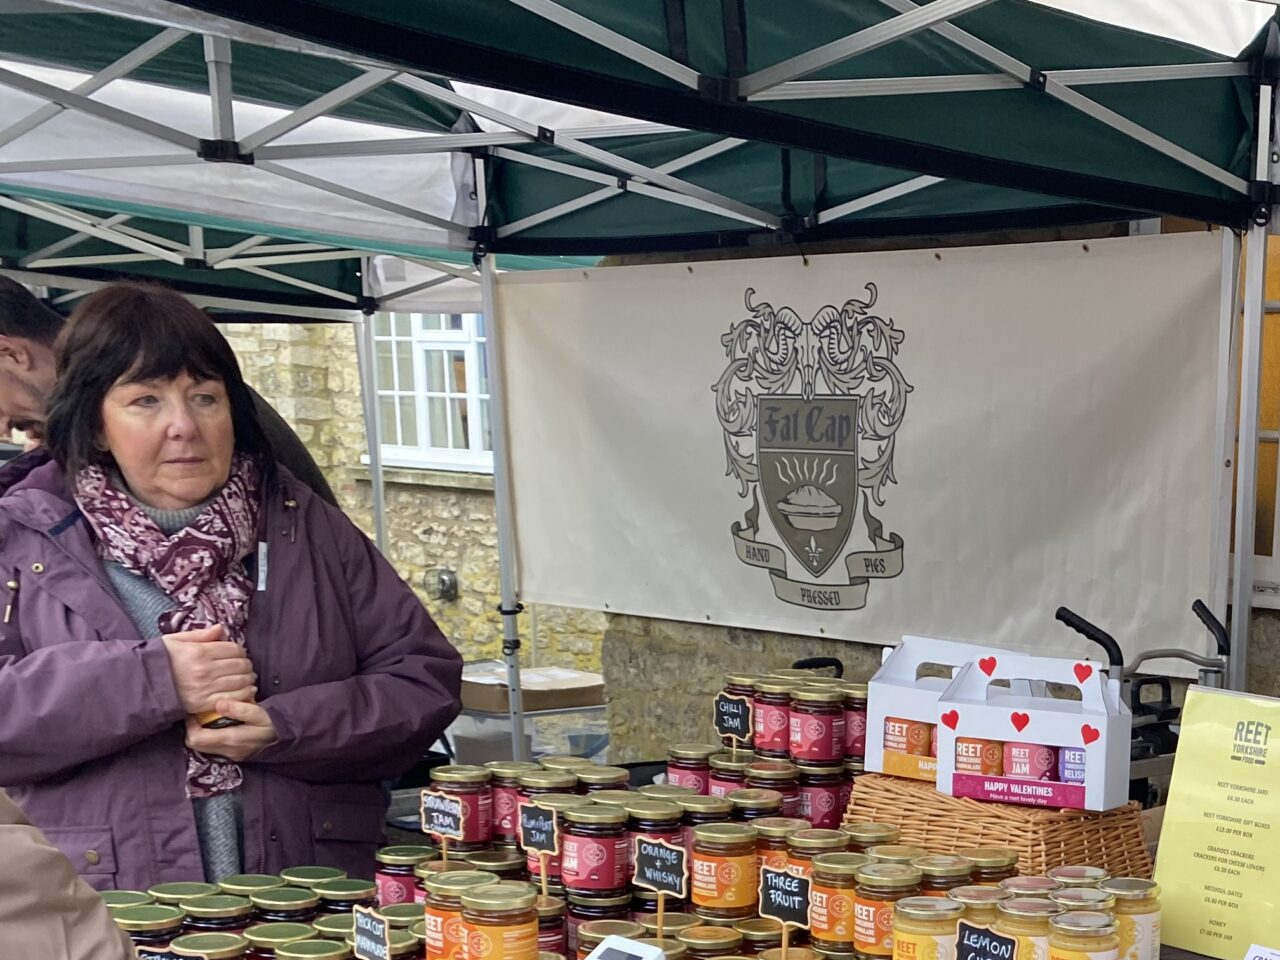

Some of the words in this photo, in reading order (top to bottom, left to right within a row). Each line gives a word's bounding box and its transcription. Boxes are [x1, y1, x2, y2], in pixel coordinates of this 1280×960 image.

[804, 405, 851, 447] Cap
[745, 545, 770, 564] HAND
[719, 701, 742, 715] CHILLI
[722, 717, 741, 730] JAM
[1233, 720, 1272, 746] REET
[1232, 742, 1268, 758] YORKSHIRE
[1011, 763, 1030, 774] JAM
[984, 781, 1008, 794] HAPPY
[1010, 783, 1053, 797] VALENTINES
[641, 843, 678, 865] ORANGE
[644, 867, 681, 890] WHISKY
[766, 872, 799, 893] THREE
[769, 889, 804, 909] FRUIT
[963, 930, 1012, 959] LEMON
